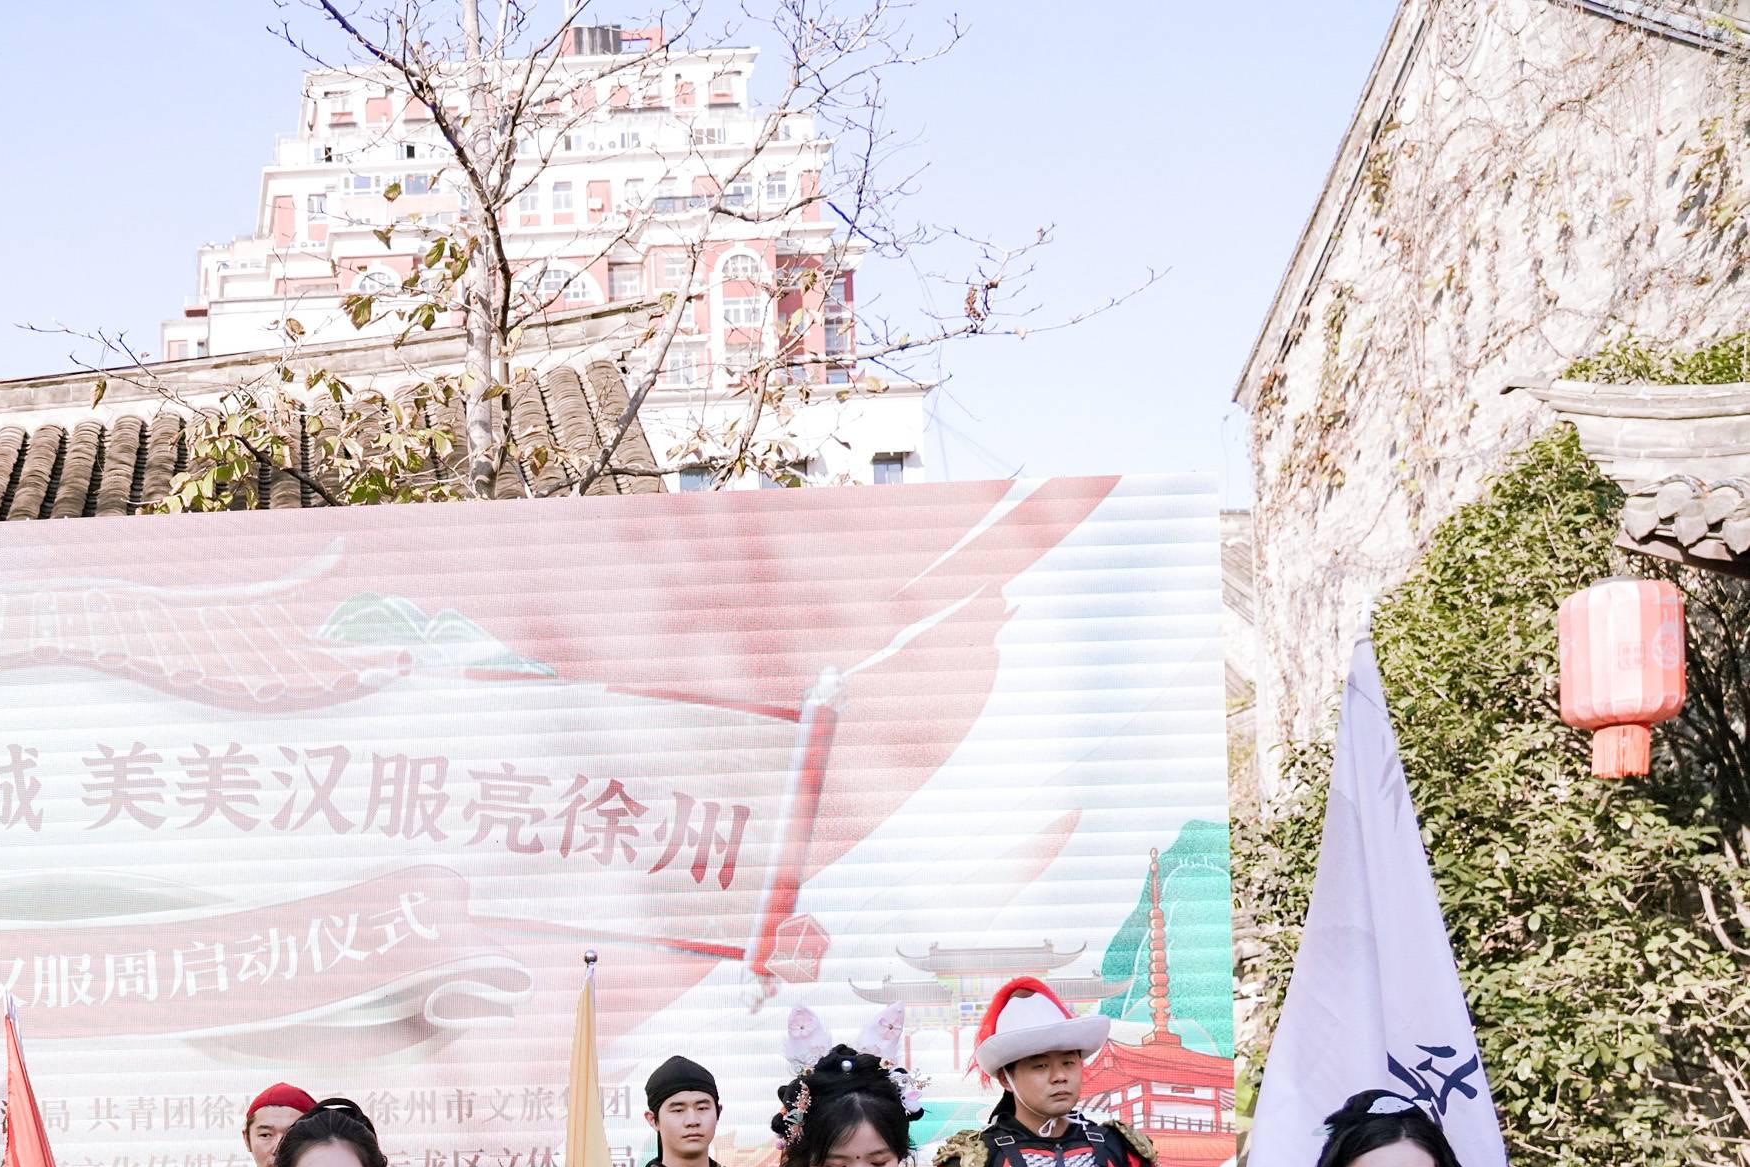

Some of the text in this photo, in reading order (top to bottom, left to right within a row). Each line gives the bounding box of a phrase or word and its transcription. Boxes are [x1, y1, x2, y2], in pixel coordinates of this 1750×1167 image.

[81, 742, 751, 890] 美美汉服亮徐州
[368, 1085, 632, 1126] 徐州市文旅团
